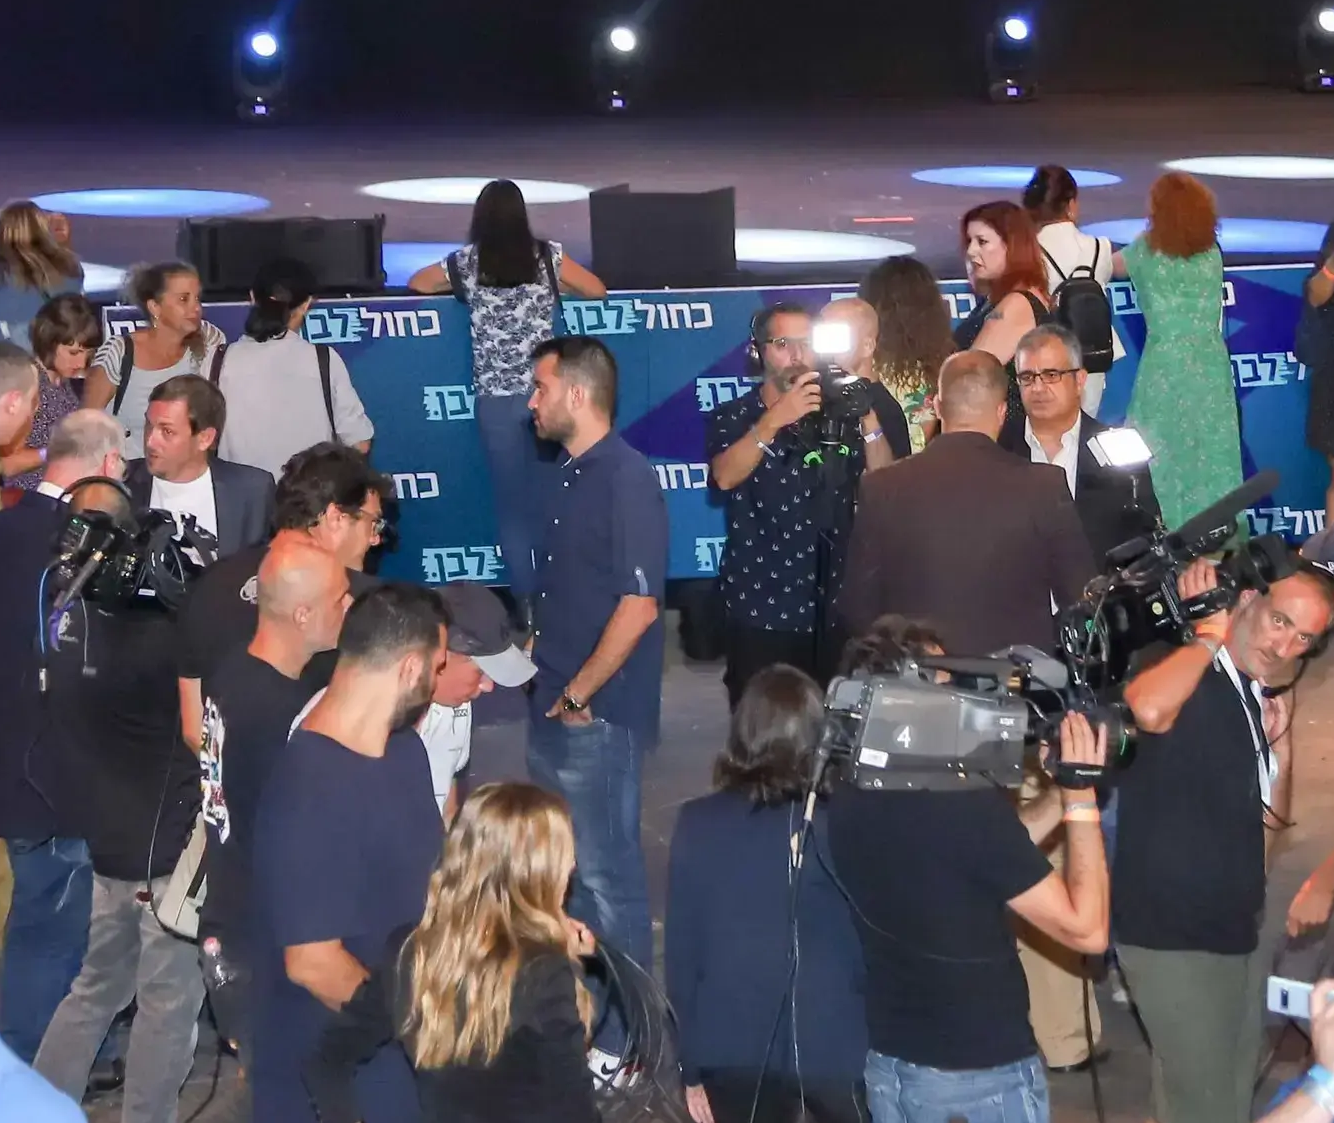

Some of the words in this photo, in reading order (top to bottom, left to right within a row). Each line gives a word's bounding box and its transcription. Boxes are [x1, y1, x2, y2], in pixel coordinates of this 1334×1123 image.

[359, 306, 442, 339] כחול
[634, 299, 714, 329] כחול
[424, 385, 476, 421] בן.
[653, 462, 710, 490] כחו
[896, 725, 912, 749] 4
